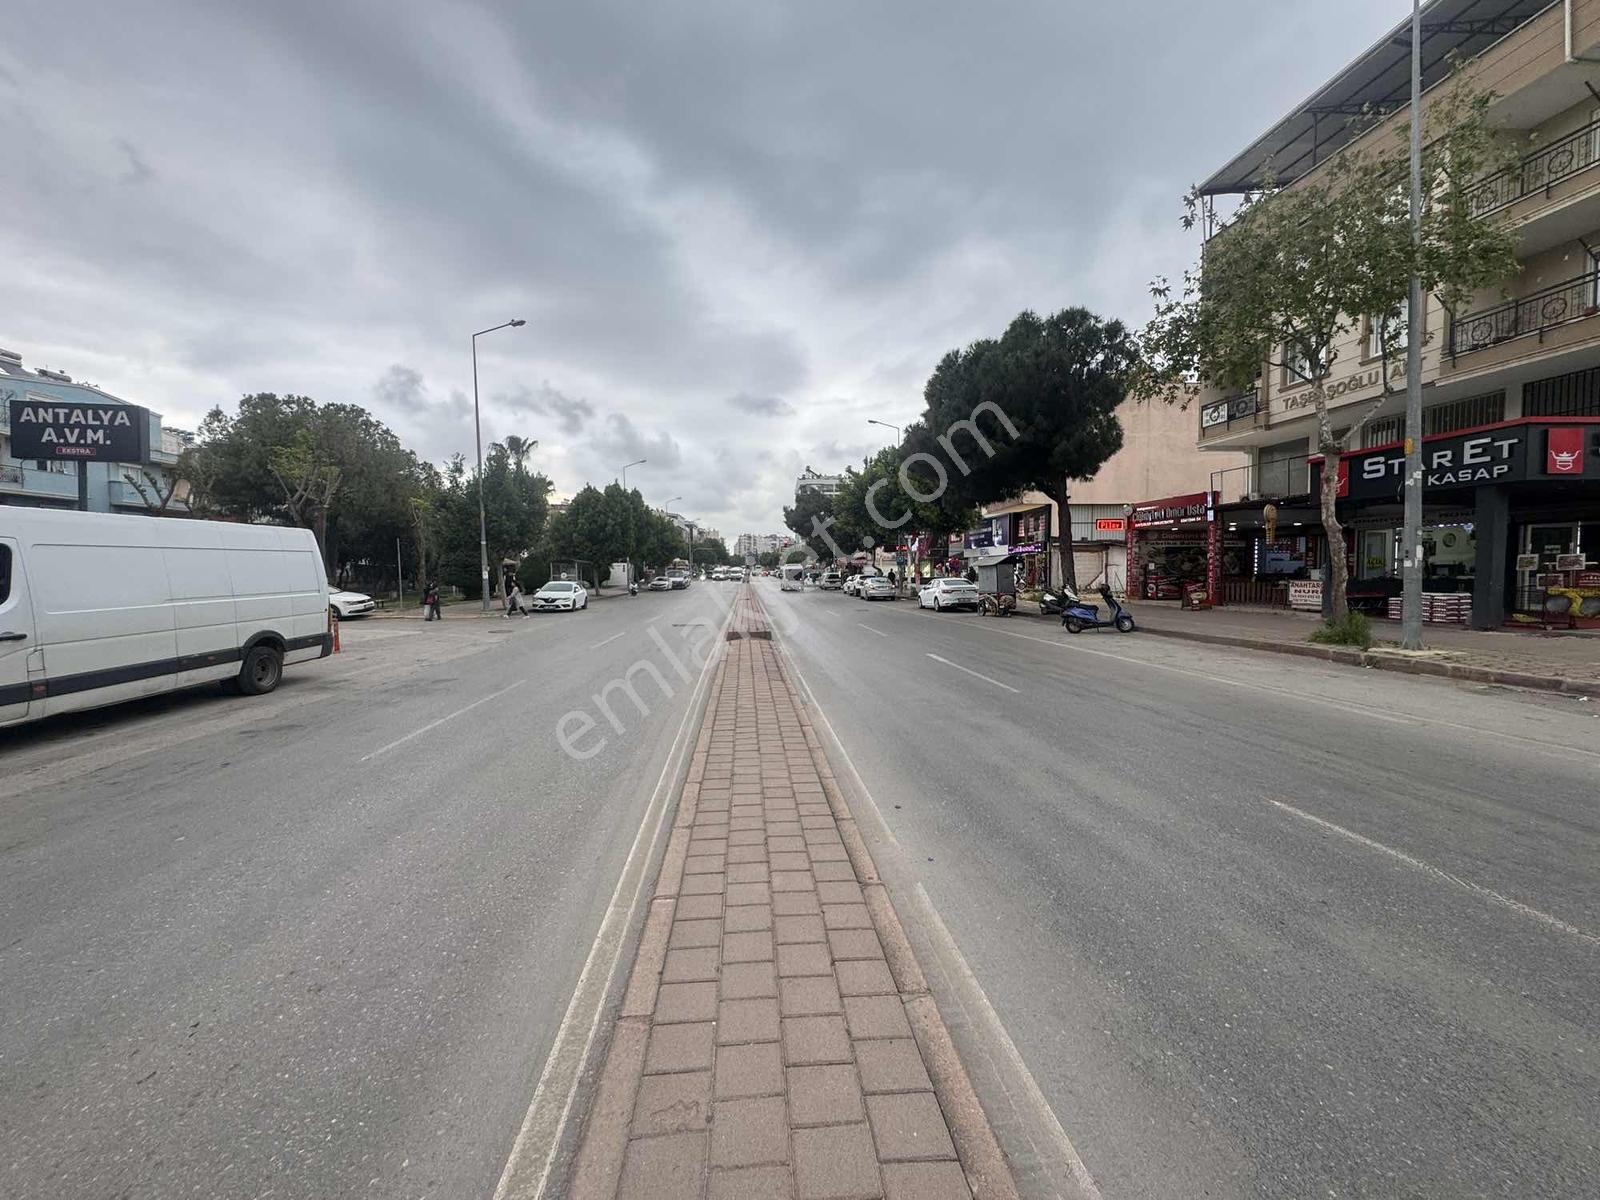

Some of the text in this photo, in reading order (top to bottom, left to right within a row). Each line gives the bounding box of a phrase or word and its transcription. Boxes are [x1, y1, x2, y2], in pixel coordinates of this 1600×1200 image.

[1282, 370, 1380, 409] TAŞŞOĞLU
[19, 407, 131, 426] ANTALYA
[41, 427, 112, 445] A.V.M.
[1362, 437, 1520, 480] STR ET
[1426, 464, 1510, 487] KASAP
